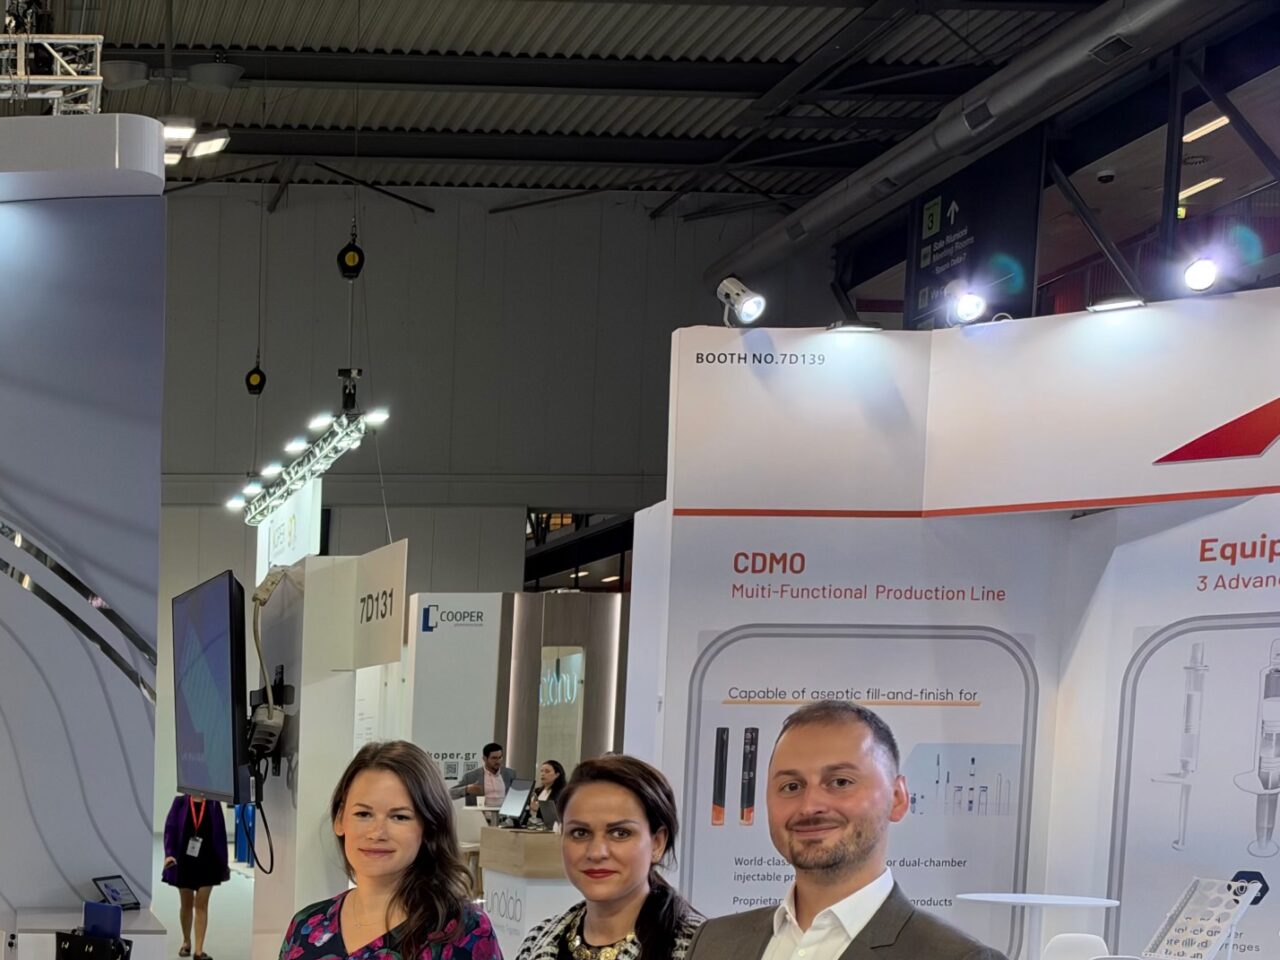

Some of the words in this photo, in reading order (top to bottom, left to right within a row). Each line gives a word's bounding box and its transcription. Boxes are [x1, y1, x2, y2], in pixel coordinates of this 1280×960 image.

[696, 352, 748, 365] BOOTH
[752, 352, 826, 366] NO.7D139
[733, 552, 806, 574] CDMO
[1196, 575, 1208, 592] 3
[1213, 573, 1280, 591] Advan
[875, 585, 966, 601] Production
[970, 586, 1007, 602] Line
[359, 587, 395, 625] 7D131
[439, 610, 484, 623] COOPER
[728, 686, 787, 702] Capable
[791, 687, 807, 700] of
[810, 688, 863, 701] aseptic
[866, 687, 955, 702] fill-and-finish
[958, 688, 979, 702] for
[886, 859, 898, 867] or
[898, 857, 968, 867] dual-chamber
[733, 872, 782, 884] injectable
[732, 896, 784, 907] Proprietar
